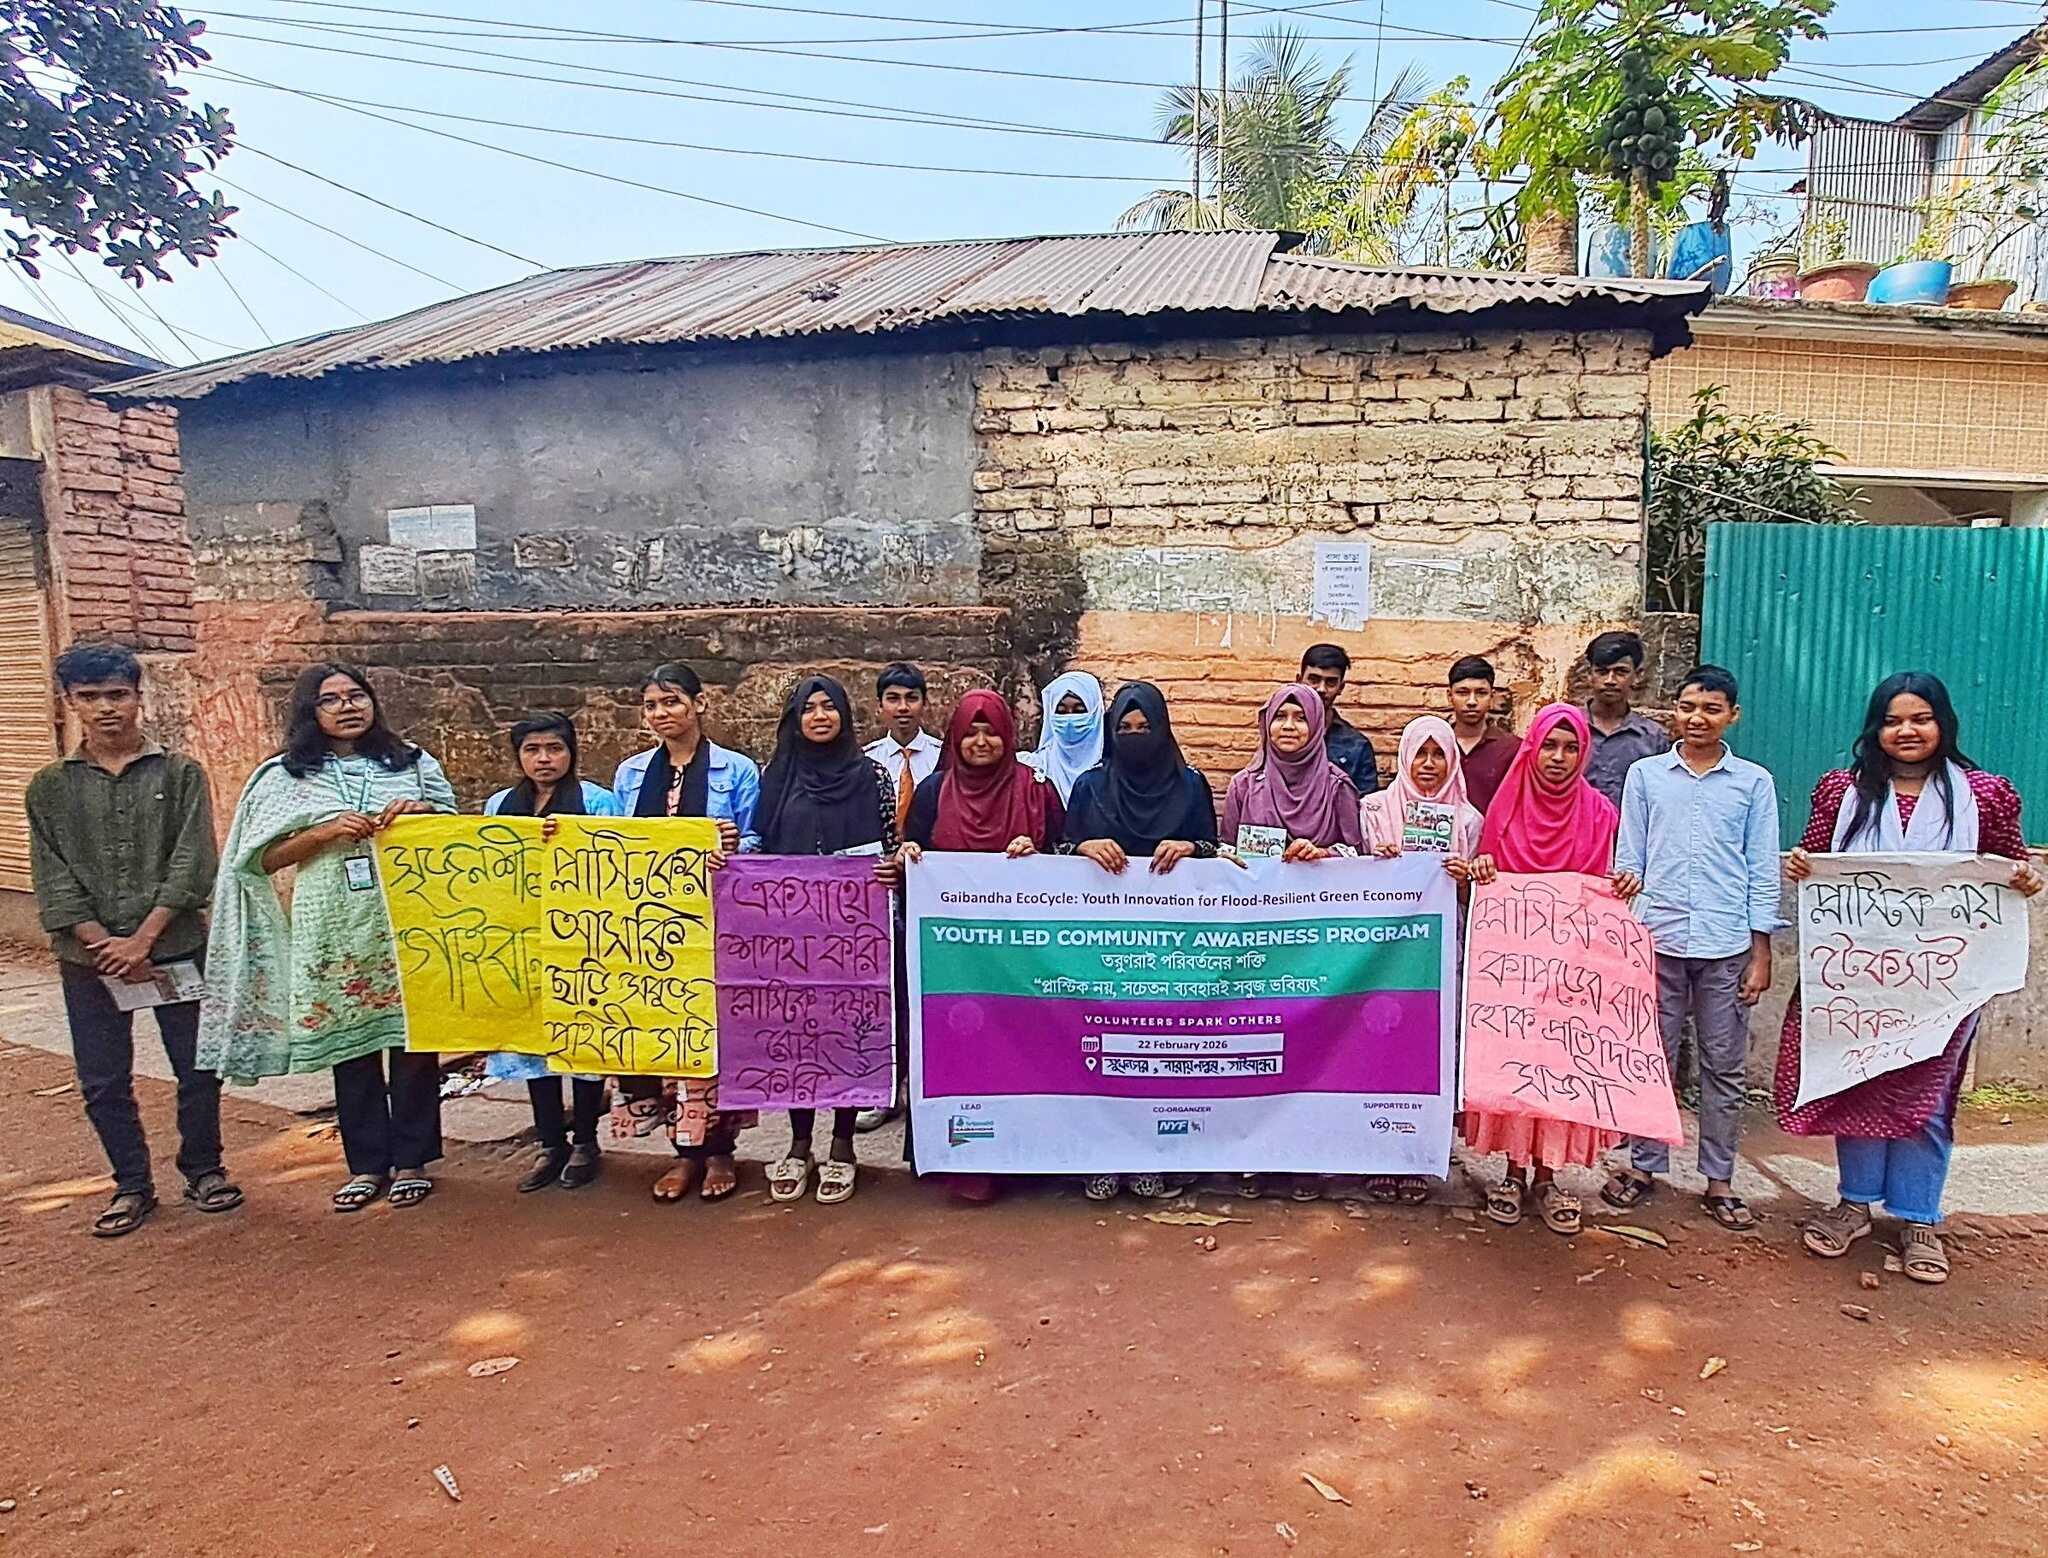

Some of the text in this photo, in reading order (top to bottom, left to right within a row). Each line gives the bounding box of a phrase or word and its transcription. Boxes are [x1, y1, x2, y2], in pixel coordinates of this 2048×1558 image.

[550, 822, 712, 901] প্লাস্টিকের
[732, 876, 881, 925] একসাথে
[940, 890, 1423, 906] Gaibandha EcoCycle: Youth Innovation for Flood-Resilient Green Economy
[1942, 882, 2011, 930] নয়
[547, 902, 709, 971] আসক্তি
[718, 922, 892, 976] শপথ করি
[932, 923, 1430, 948] YOUTH LED COMMUNITY AWARENESS PROGRAM
[1602, 912, 1653, 975] নয়
[1101, 951, 1267, 973] তরুণরাই পরিবর্তনের শক্তি
[1810, 932, 1969, 1002] টেকসই
[619, 972, 716, 1016] সবুজ
[1092, 981, 1117, 998] নয়,
[1120, 981, 1170, 996] সচেতন
[1173, 979, 1230, 998] ব্যবহারই
[1233, 980, 1267, 998] সবুজ
[544, 1003, 644, 1071] পৃথিবী
[1084, 1015, 1282, 1026] VOLUNTEERS SPARK OTHERS
[1138, 1040, 1228, 1050] 22 February 2026
[1469, 1003, 1668, 1087] হোক প্রতিদিনের
[736, 1062, 838, 1103] করি
[1159, 1121, 1188, 1131] NYF
